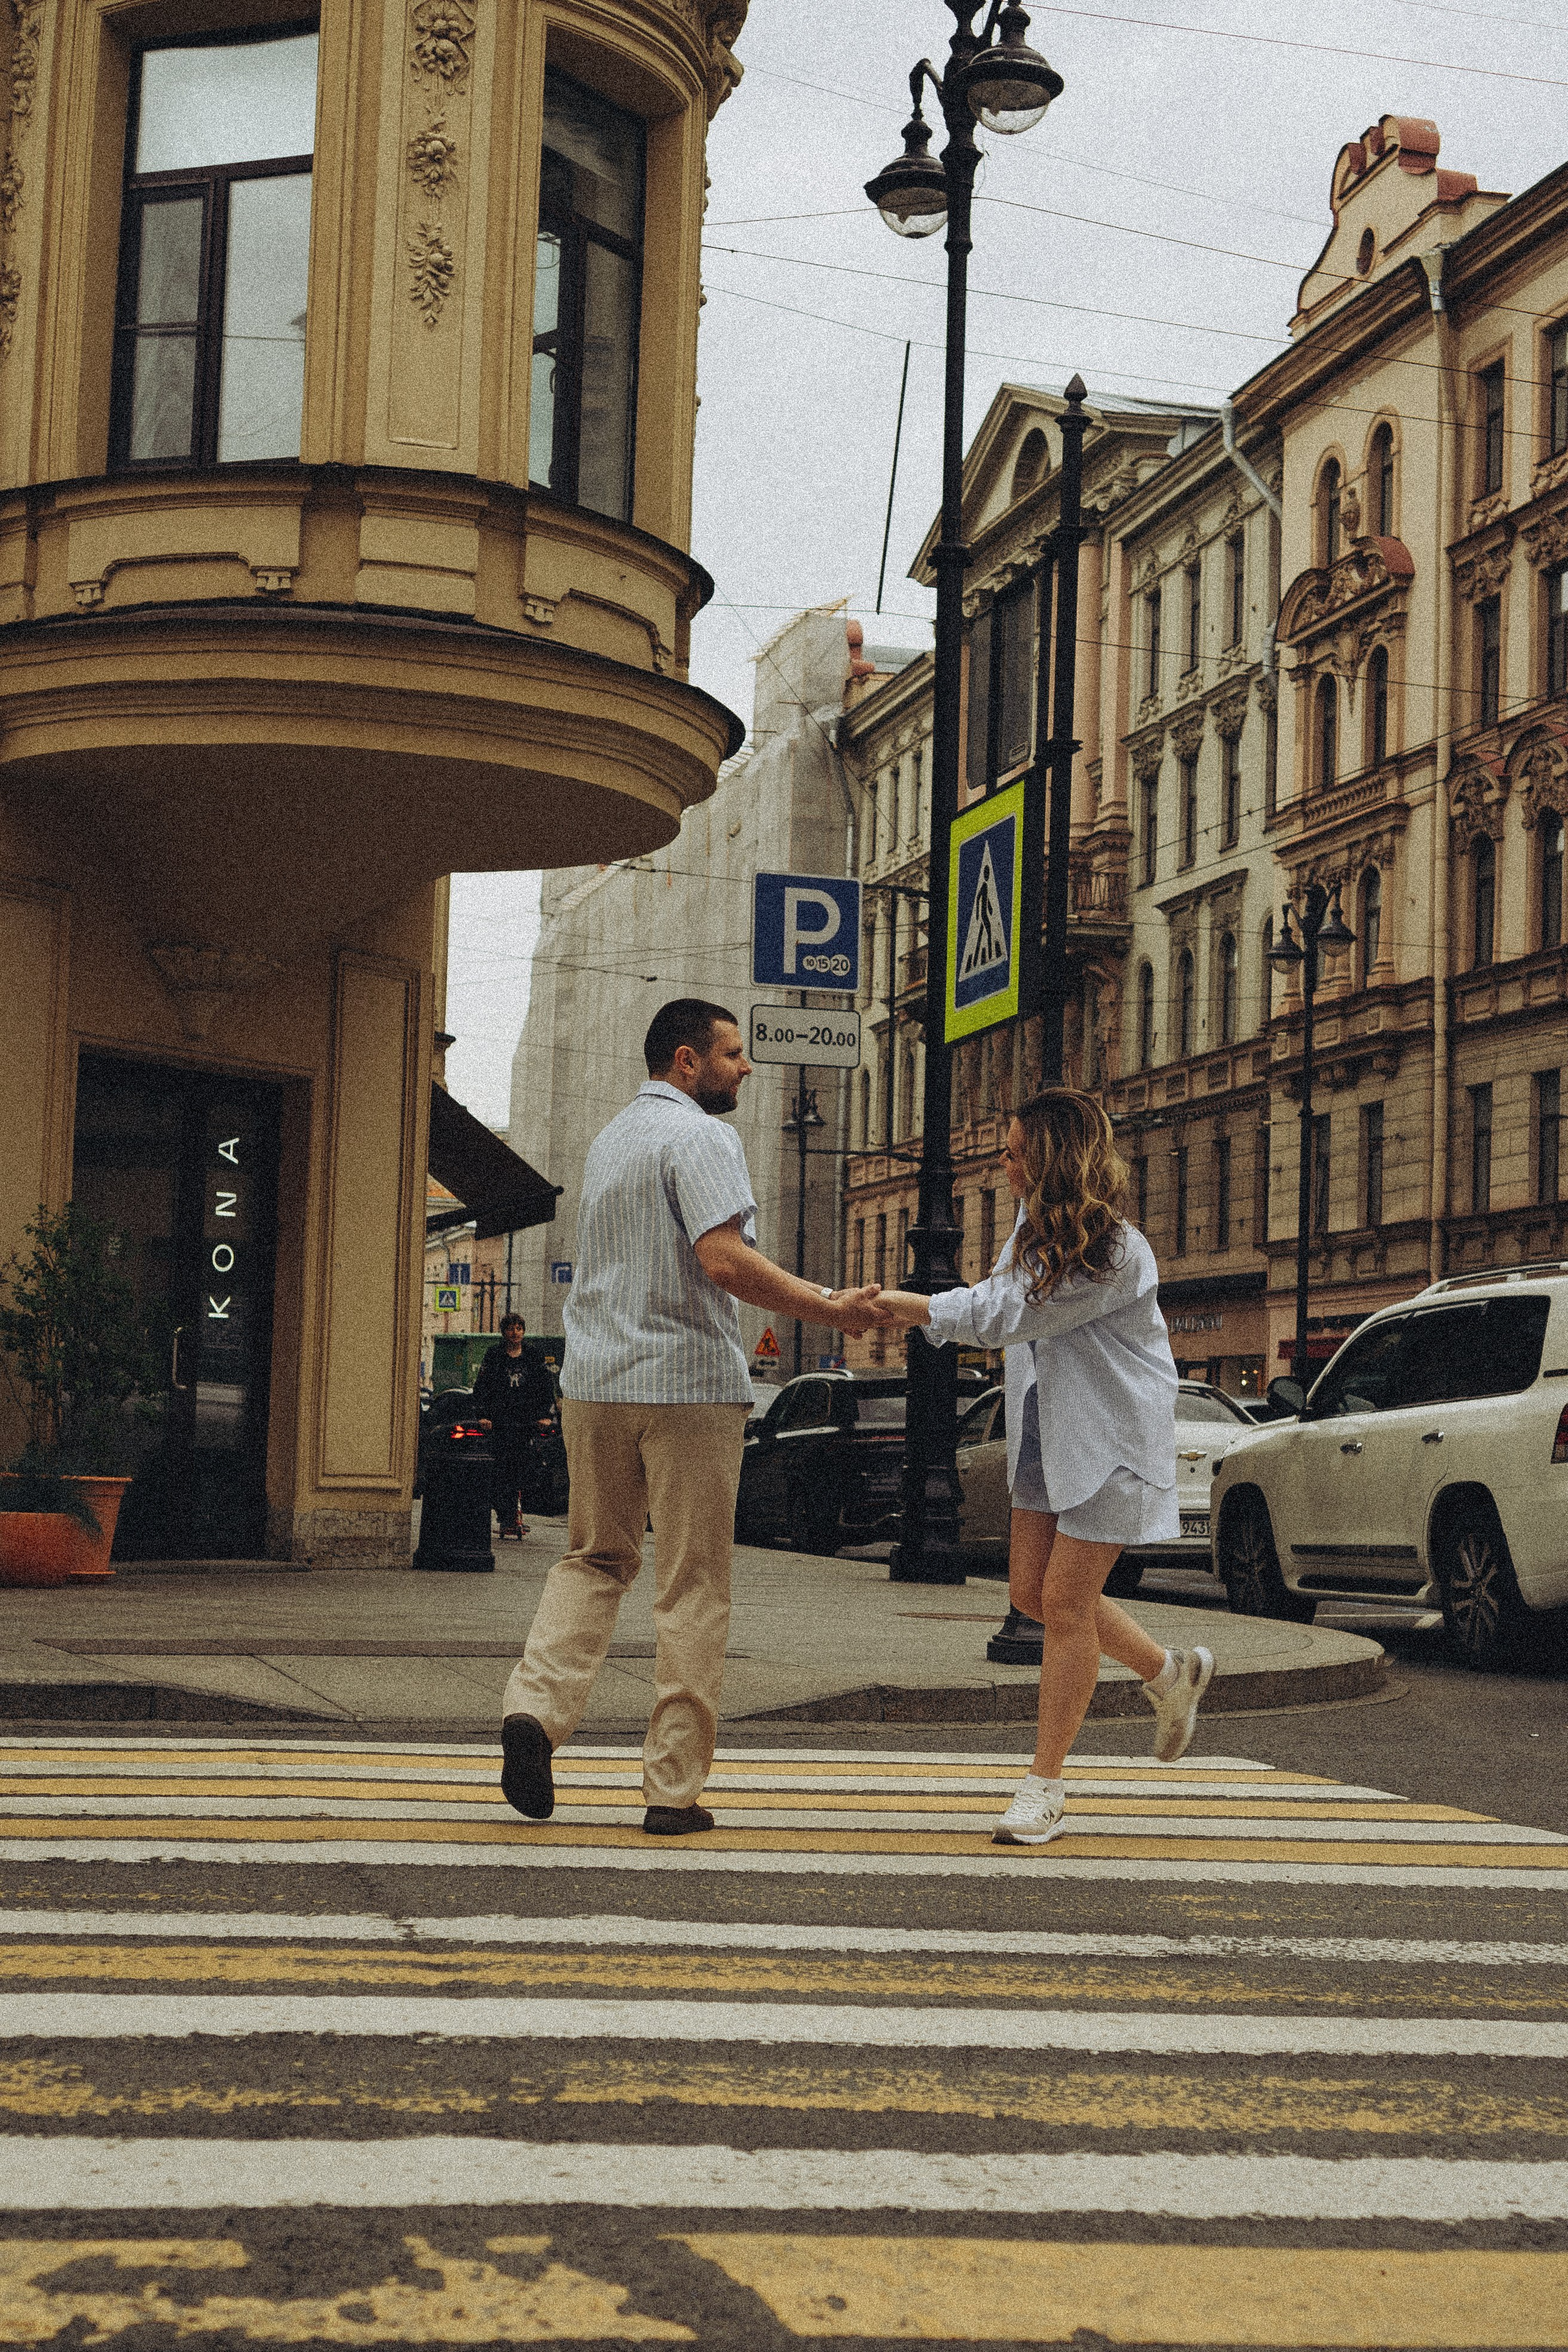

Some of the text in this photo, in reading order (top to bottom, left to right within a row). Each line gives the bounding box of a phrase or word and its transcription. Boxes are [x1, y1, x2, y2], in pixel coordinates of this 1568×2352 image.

[784, 887, 841, 974] P
[832, 958, 849, 971] 20
[208, 1137, 240, 1319] KONA
